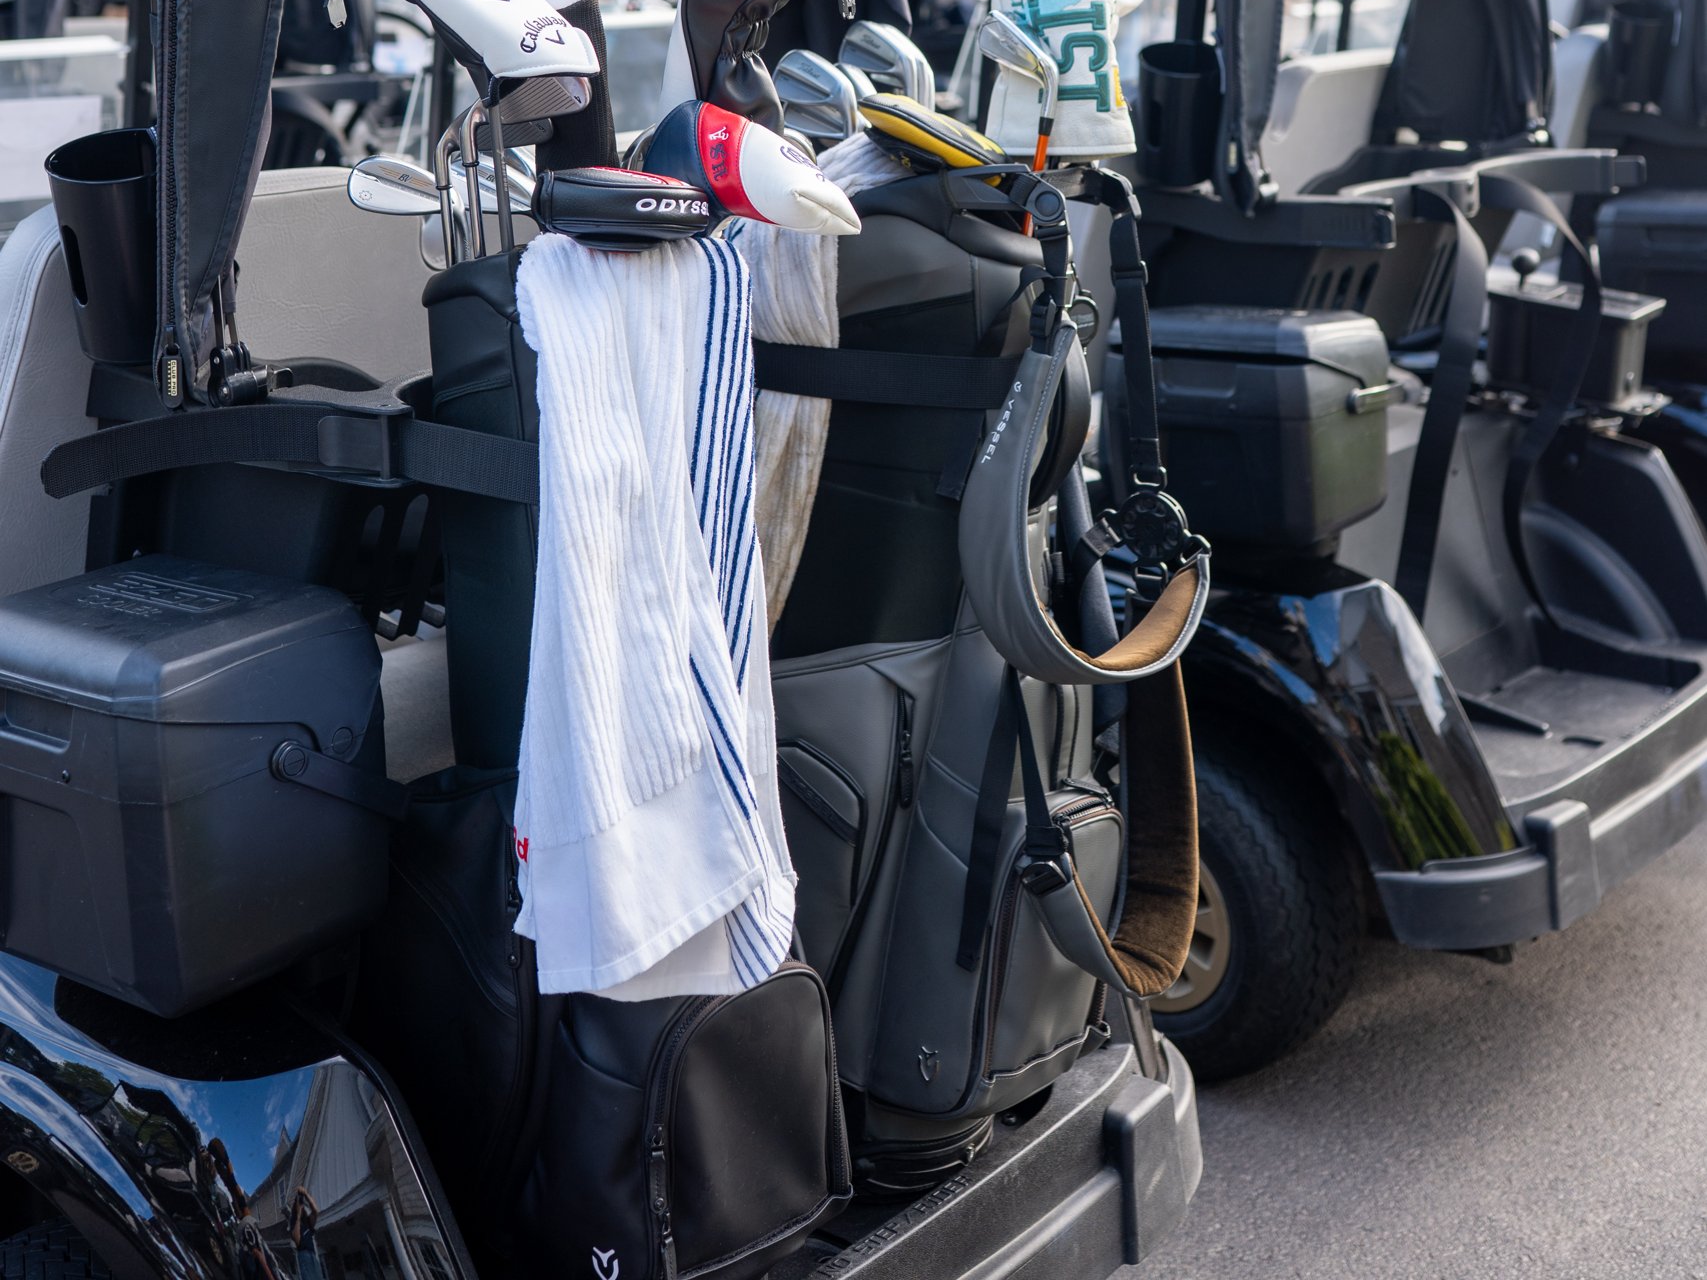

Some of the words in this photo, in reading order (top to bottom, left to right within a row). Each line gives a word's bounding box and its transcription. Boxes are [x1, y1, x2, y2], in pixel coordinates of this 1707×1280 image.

[520, 16, 567, 53] Callaway
[981, 399, 1015, 463] VESSEL
[853, 1221, 900, 1255] STEP
[913, 1175, 972, 1215] RIDER
